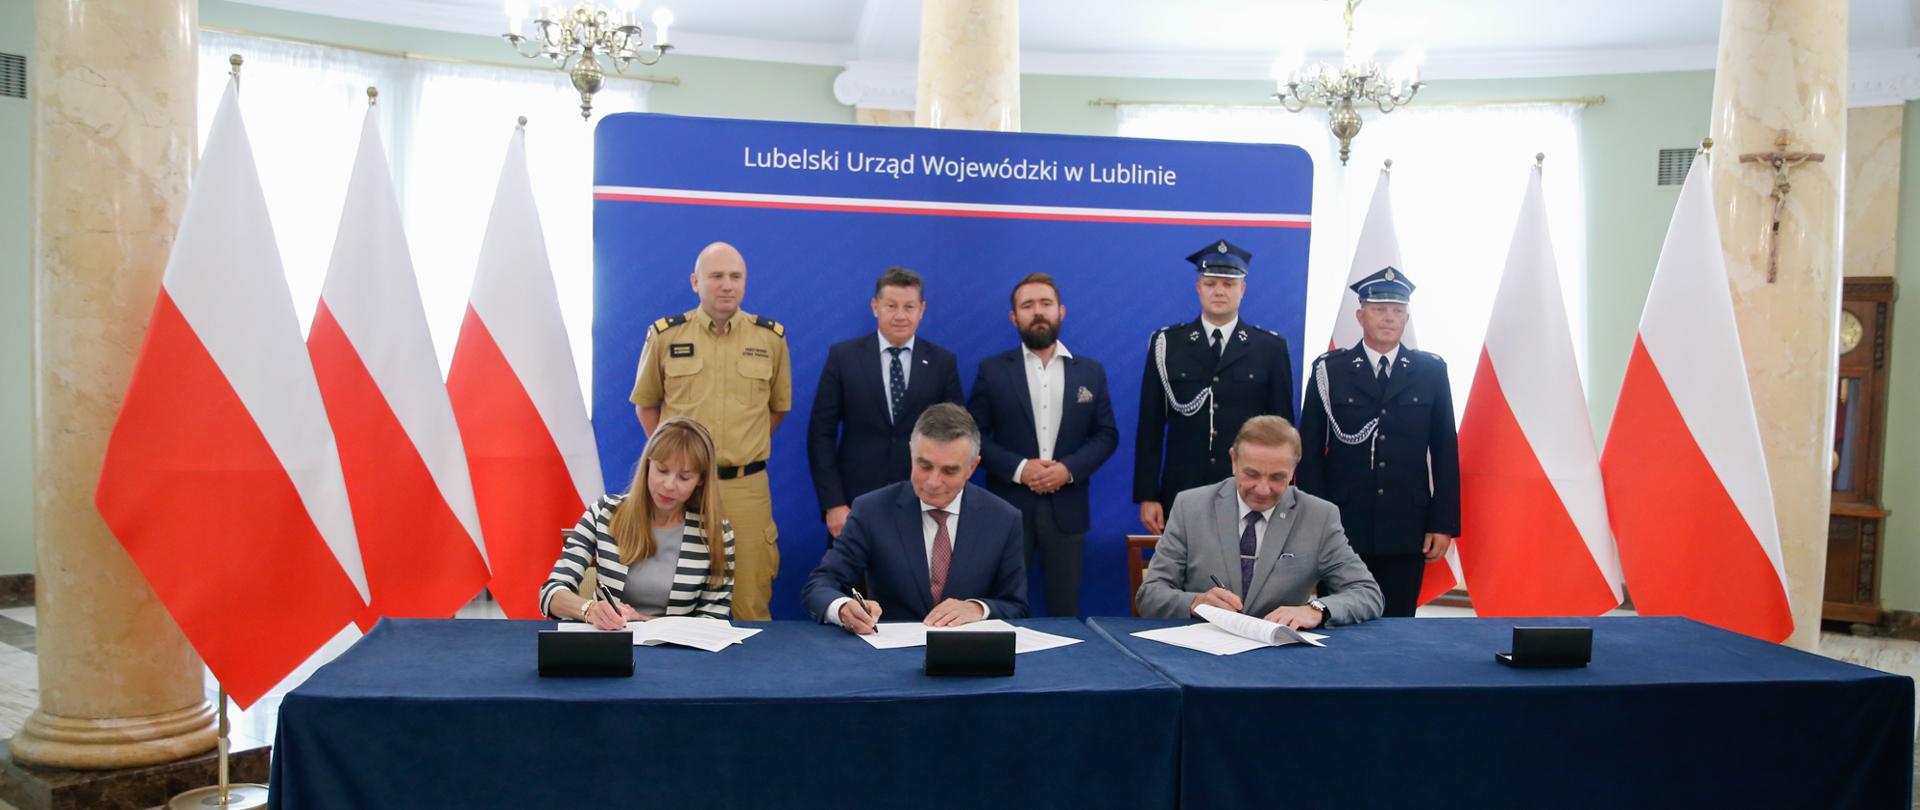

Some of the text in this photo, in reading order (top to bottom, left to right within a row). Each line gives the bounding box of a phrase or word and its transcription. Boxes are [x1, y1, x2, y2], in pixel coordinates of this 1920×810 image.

[744, 146, 1177, 186] Lubelski Urząd Wojewódzki w Lublinie
